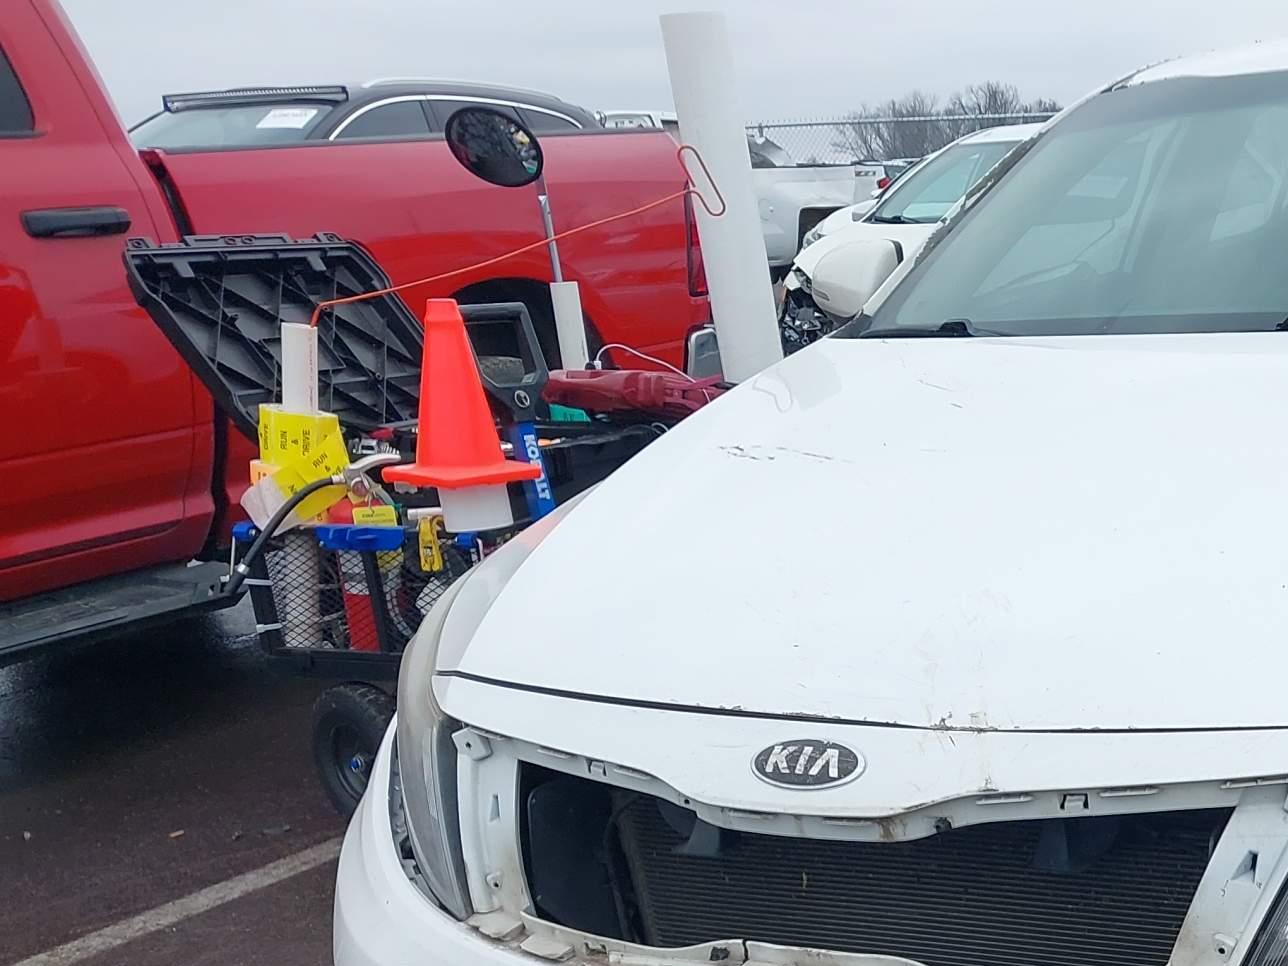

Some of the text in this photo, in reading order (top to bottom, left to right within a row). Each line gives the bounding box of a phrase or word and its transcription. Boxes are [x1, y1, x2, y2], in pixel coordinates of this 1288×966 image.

[279, 430, 288, 450] RUN
[291, 438, 299, 446] &
[312, 452, 328, 469] RUN
[523, 433, 551, 500] KOLT
[764, 744, 841, 778] KIA
